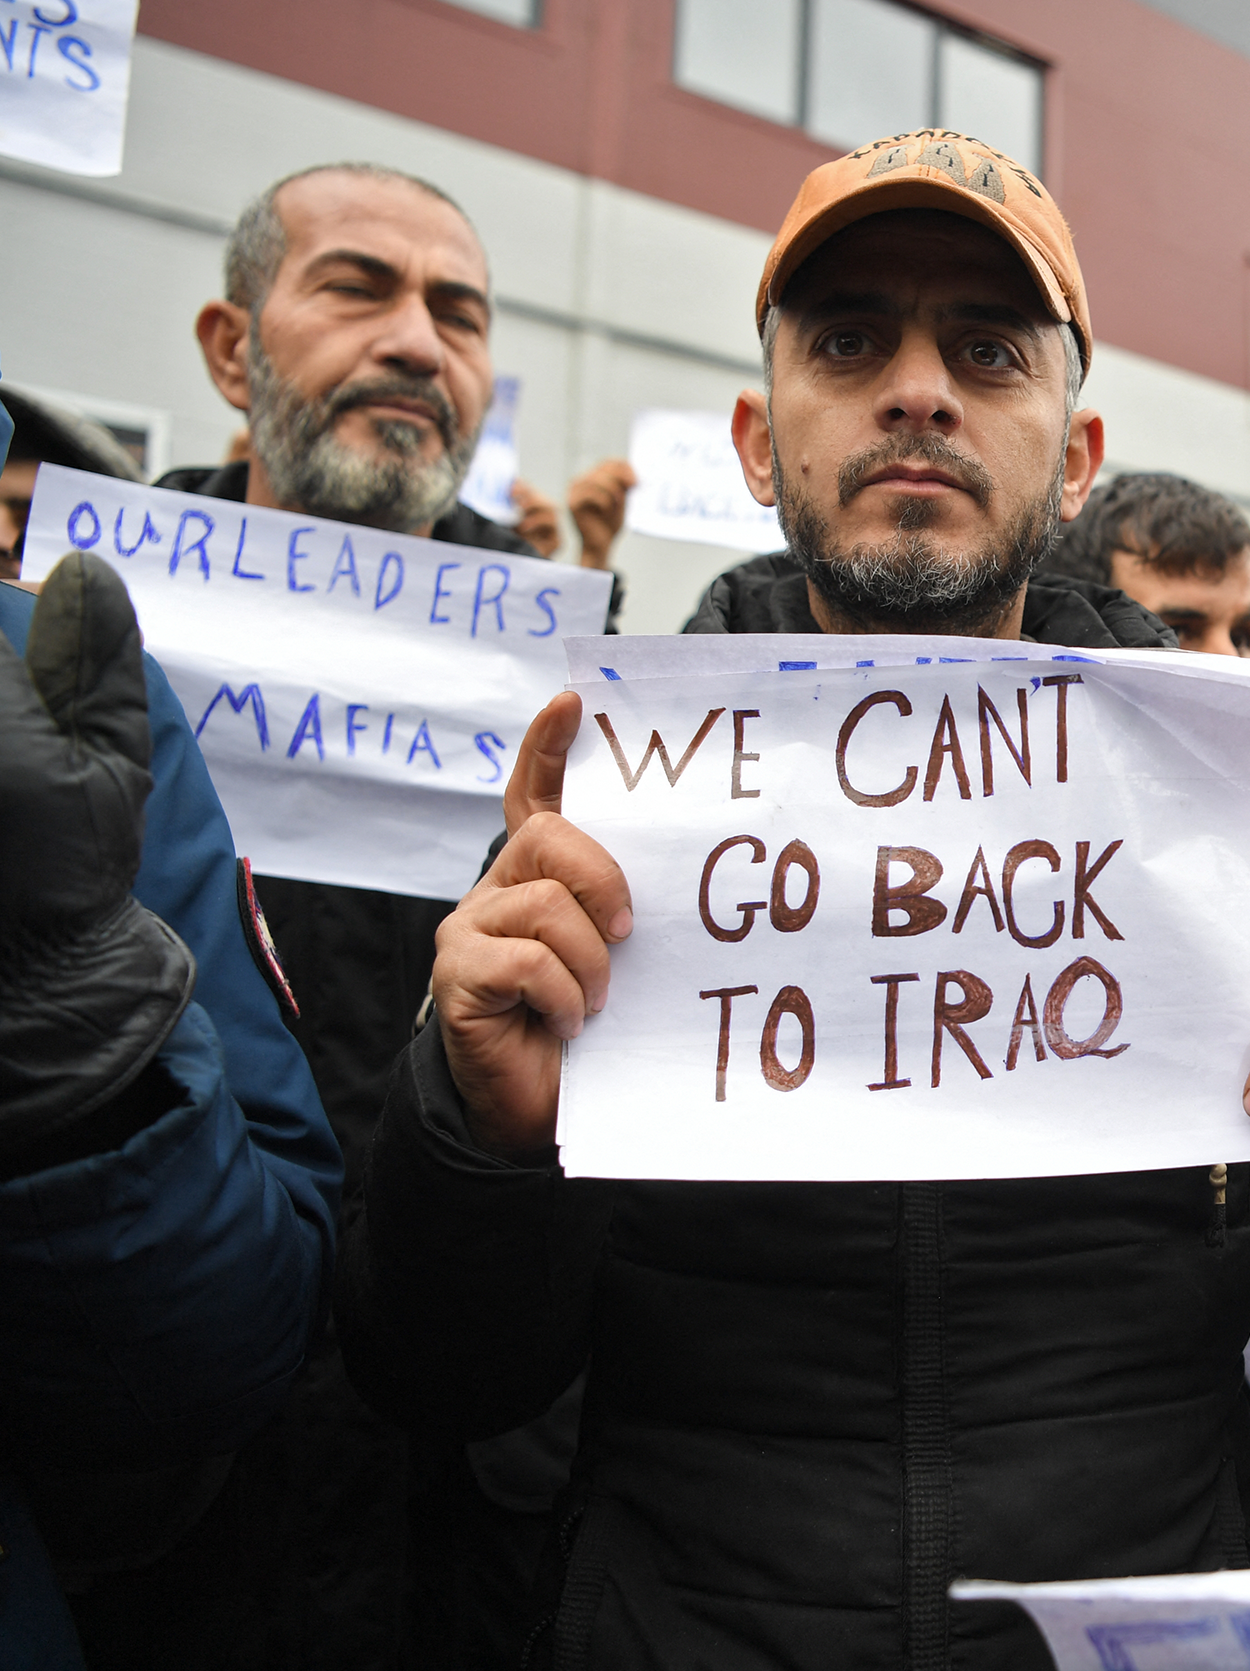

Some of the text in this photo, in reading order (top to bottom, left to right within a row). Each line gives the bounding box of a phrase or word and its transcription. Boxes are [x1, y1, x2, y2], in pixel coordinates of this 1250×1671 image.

[195, 683, 507, 783] MAFIAS
[595, 673, 1085, 808] WE CAN'T
[699, 834, 1125, 948] GO BACK
[699, 955, 1131, 1102] TO IRAQ
